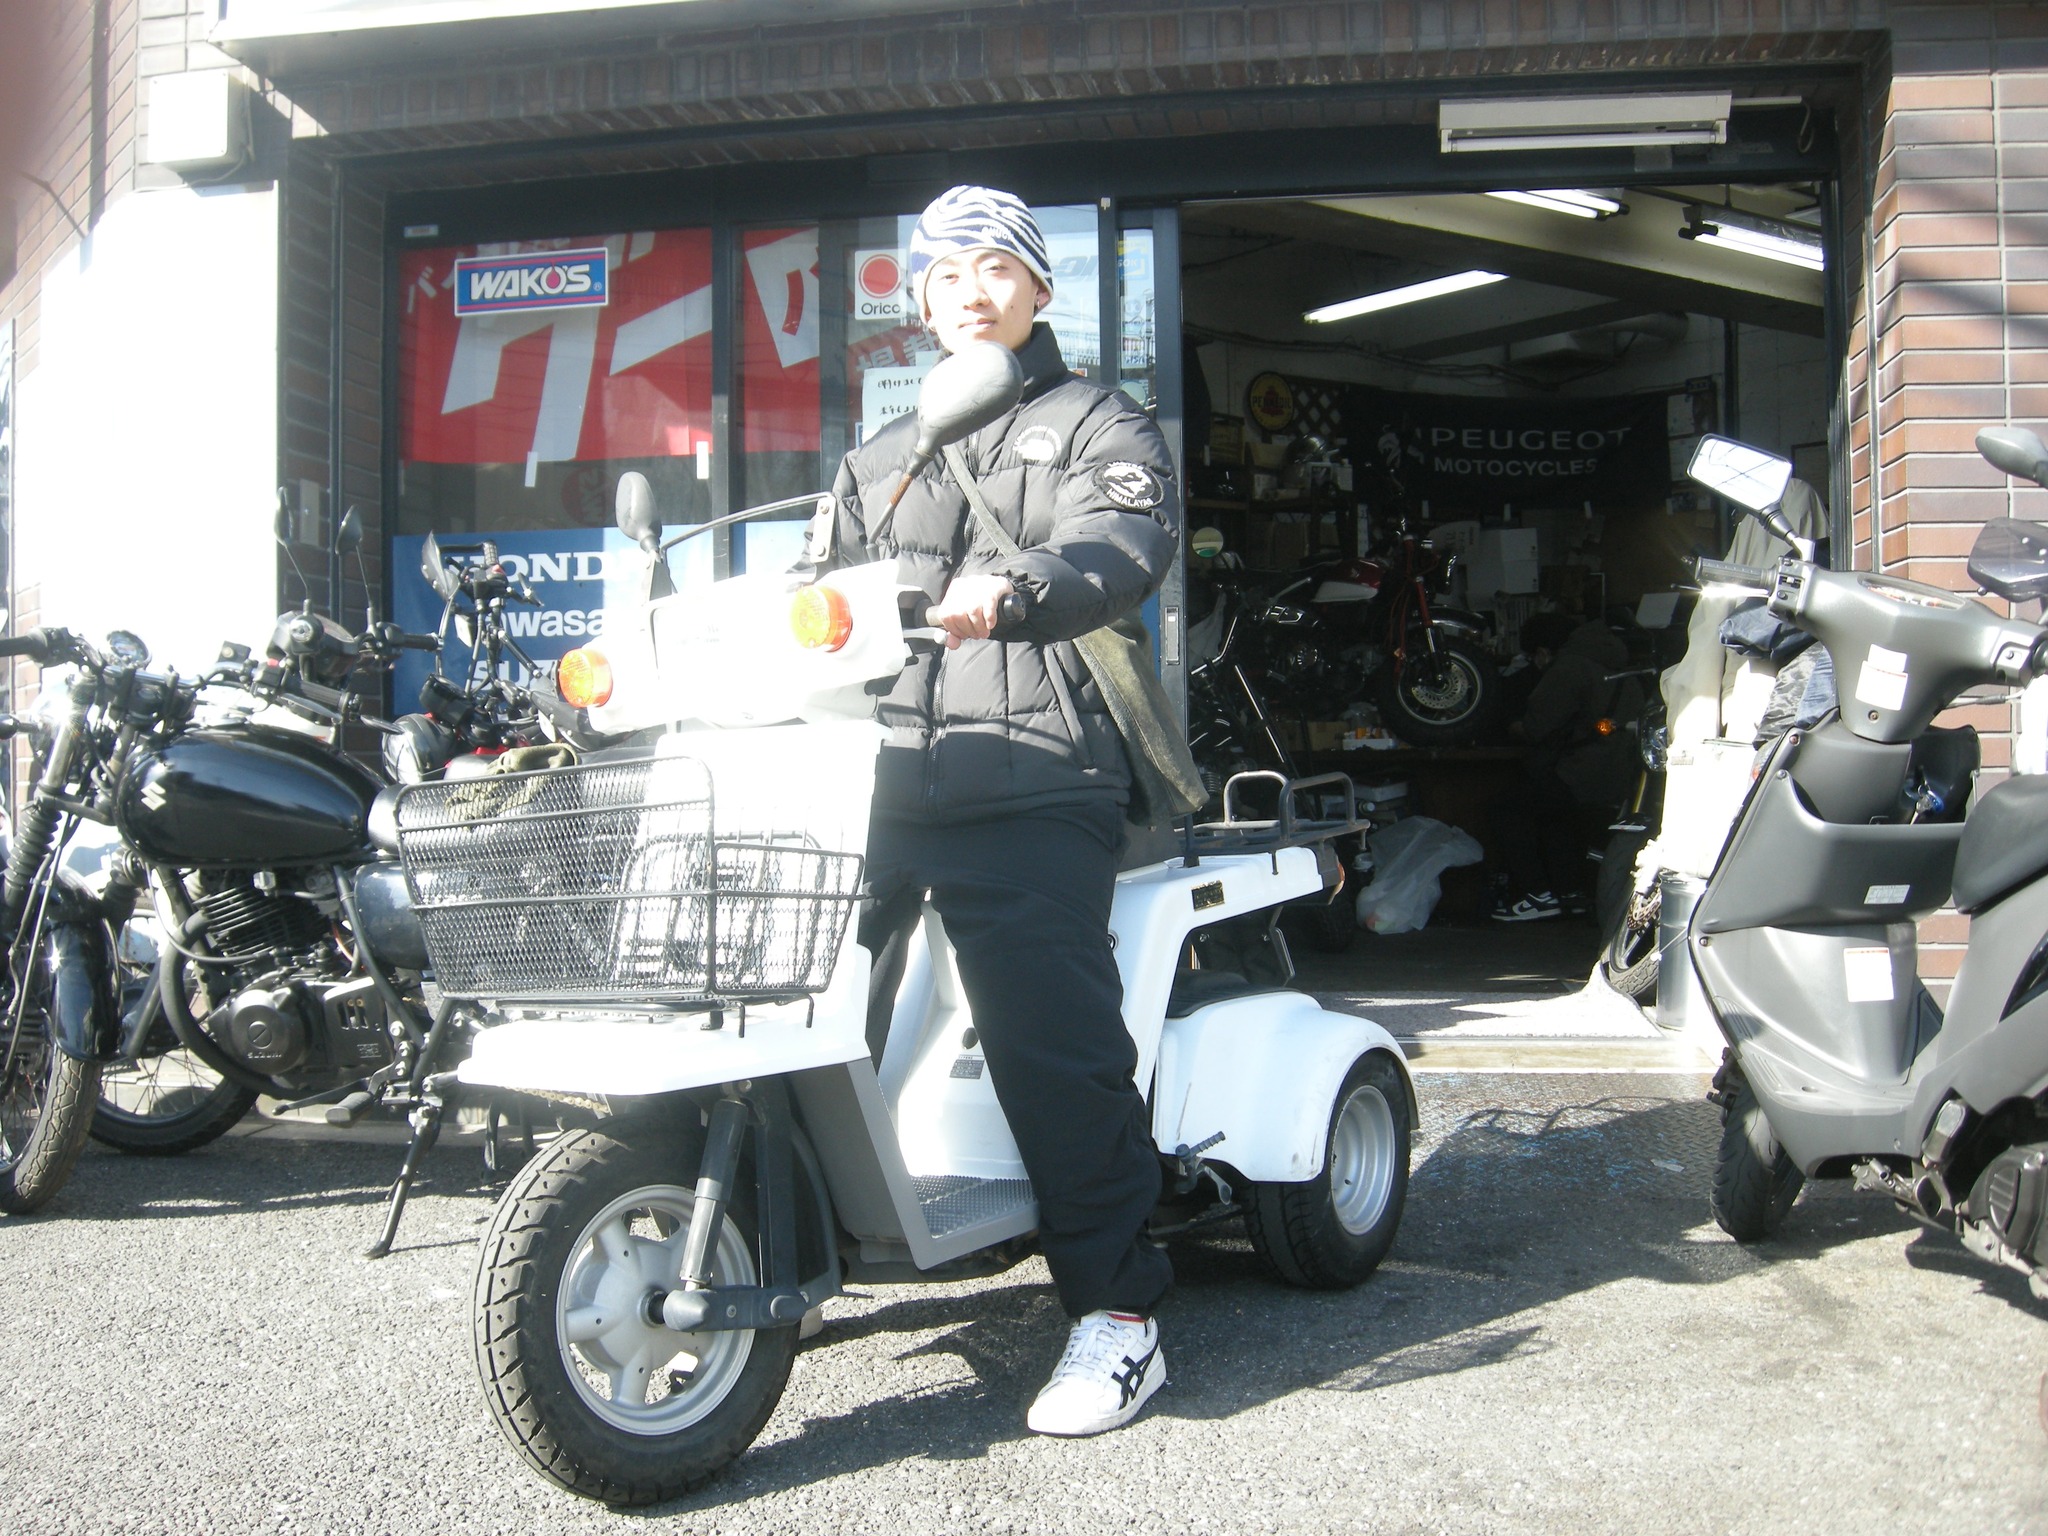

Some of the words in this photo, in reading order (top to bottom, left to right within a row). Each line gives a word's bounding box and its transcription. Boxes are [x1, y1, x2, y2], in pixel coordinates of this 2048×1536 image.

[470, 262, 592, 301] WAKO'S
[1431, 426, 1632, 451] PEUGEOT
[1434, 457, 1599, 477] MOTOCYCLES
